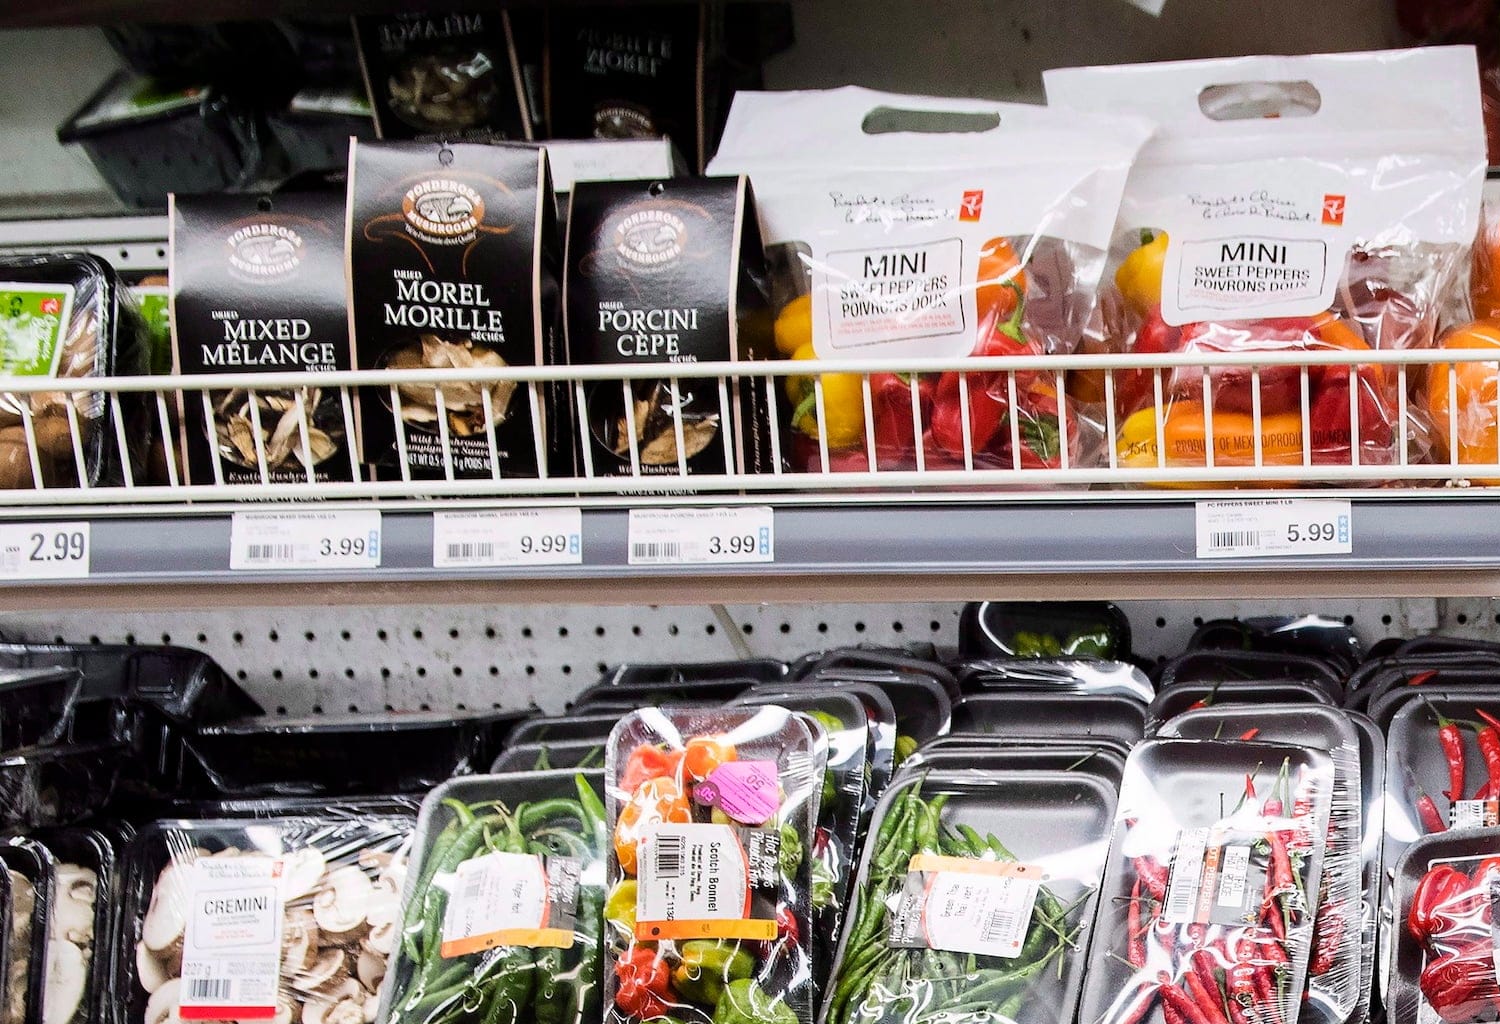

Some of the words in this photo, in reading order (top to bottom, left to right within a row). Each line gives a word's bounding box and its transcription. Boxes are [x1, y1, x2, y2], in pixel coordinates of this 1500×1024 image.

[407, 179, 483, 206] PONDEROSA
[407, 211, 478, 236] MUSHROOMS
[617, 210, 685, 234] PONDEROSA
[226, 223, 303, 248] PONDEROSA
[229, 254, 300, 276] MUSHROOMS
[617, 242, 682, 264] MUSHROOMS
[863, 251, 927, 279] MINI
[1220, 242, 1288, 265] MINI
[393, 268, 424, 280] DRIED
[1194, 264, 1243, 280] SWEET
[1246, 265, 1310, 281] PEPPERS
[396, 279, 491, 307] MOREL
[1193, 277, 1268, 294] POIVRONS
[1269, 280, 1308, 291] DOUX
[384, 302, 504, 333] MORILLE
[598, 307, 699, 332] PORCINI
[224, 318, 312, 342] MIXED
[201, 341, 337, 366] MÉLANGE
[616, 331, 681, 357] CÈPE
[520, 534, 567, 554] 9.99
[709, 535, 756, 554] 3.99
[1287, 523, 1336, 543] 5.99
[29, 532, 86, 562] 2.99
[319, 537, 366, 557] 3.99
[748, 831, 763, 867] Piments
[764, 834, 780, 855] Hot
[709, 841, 721, 874] Scotch
[747, 868, 761, 890] Fort
[758, 854, 778, 889] Peppers
[707, 877, 719, 912] Bonnet
[1200, 866, 1217, 912] PEPPERS
[204, 896, 268, 916] CREMINI
